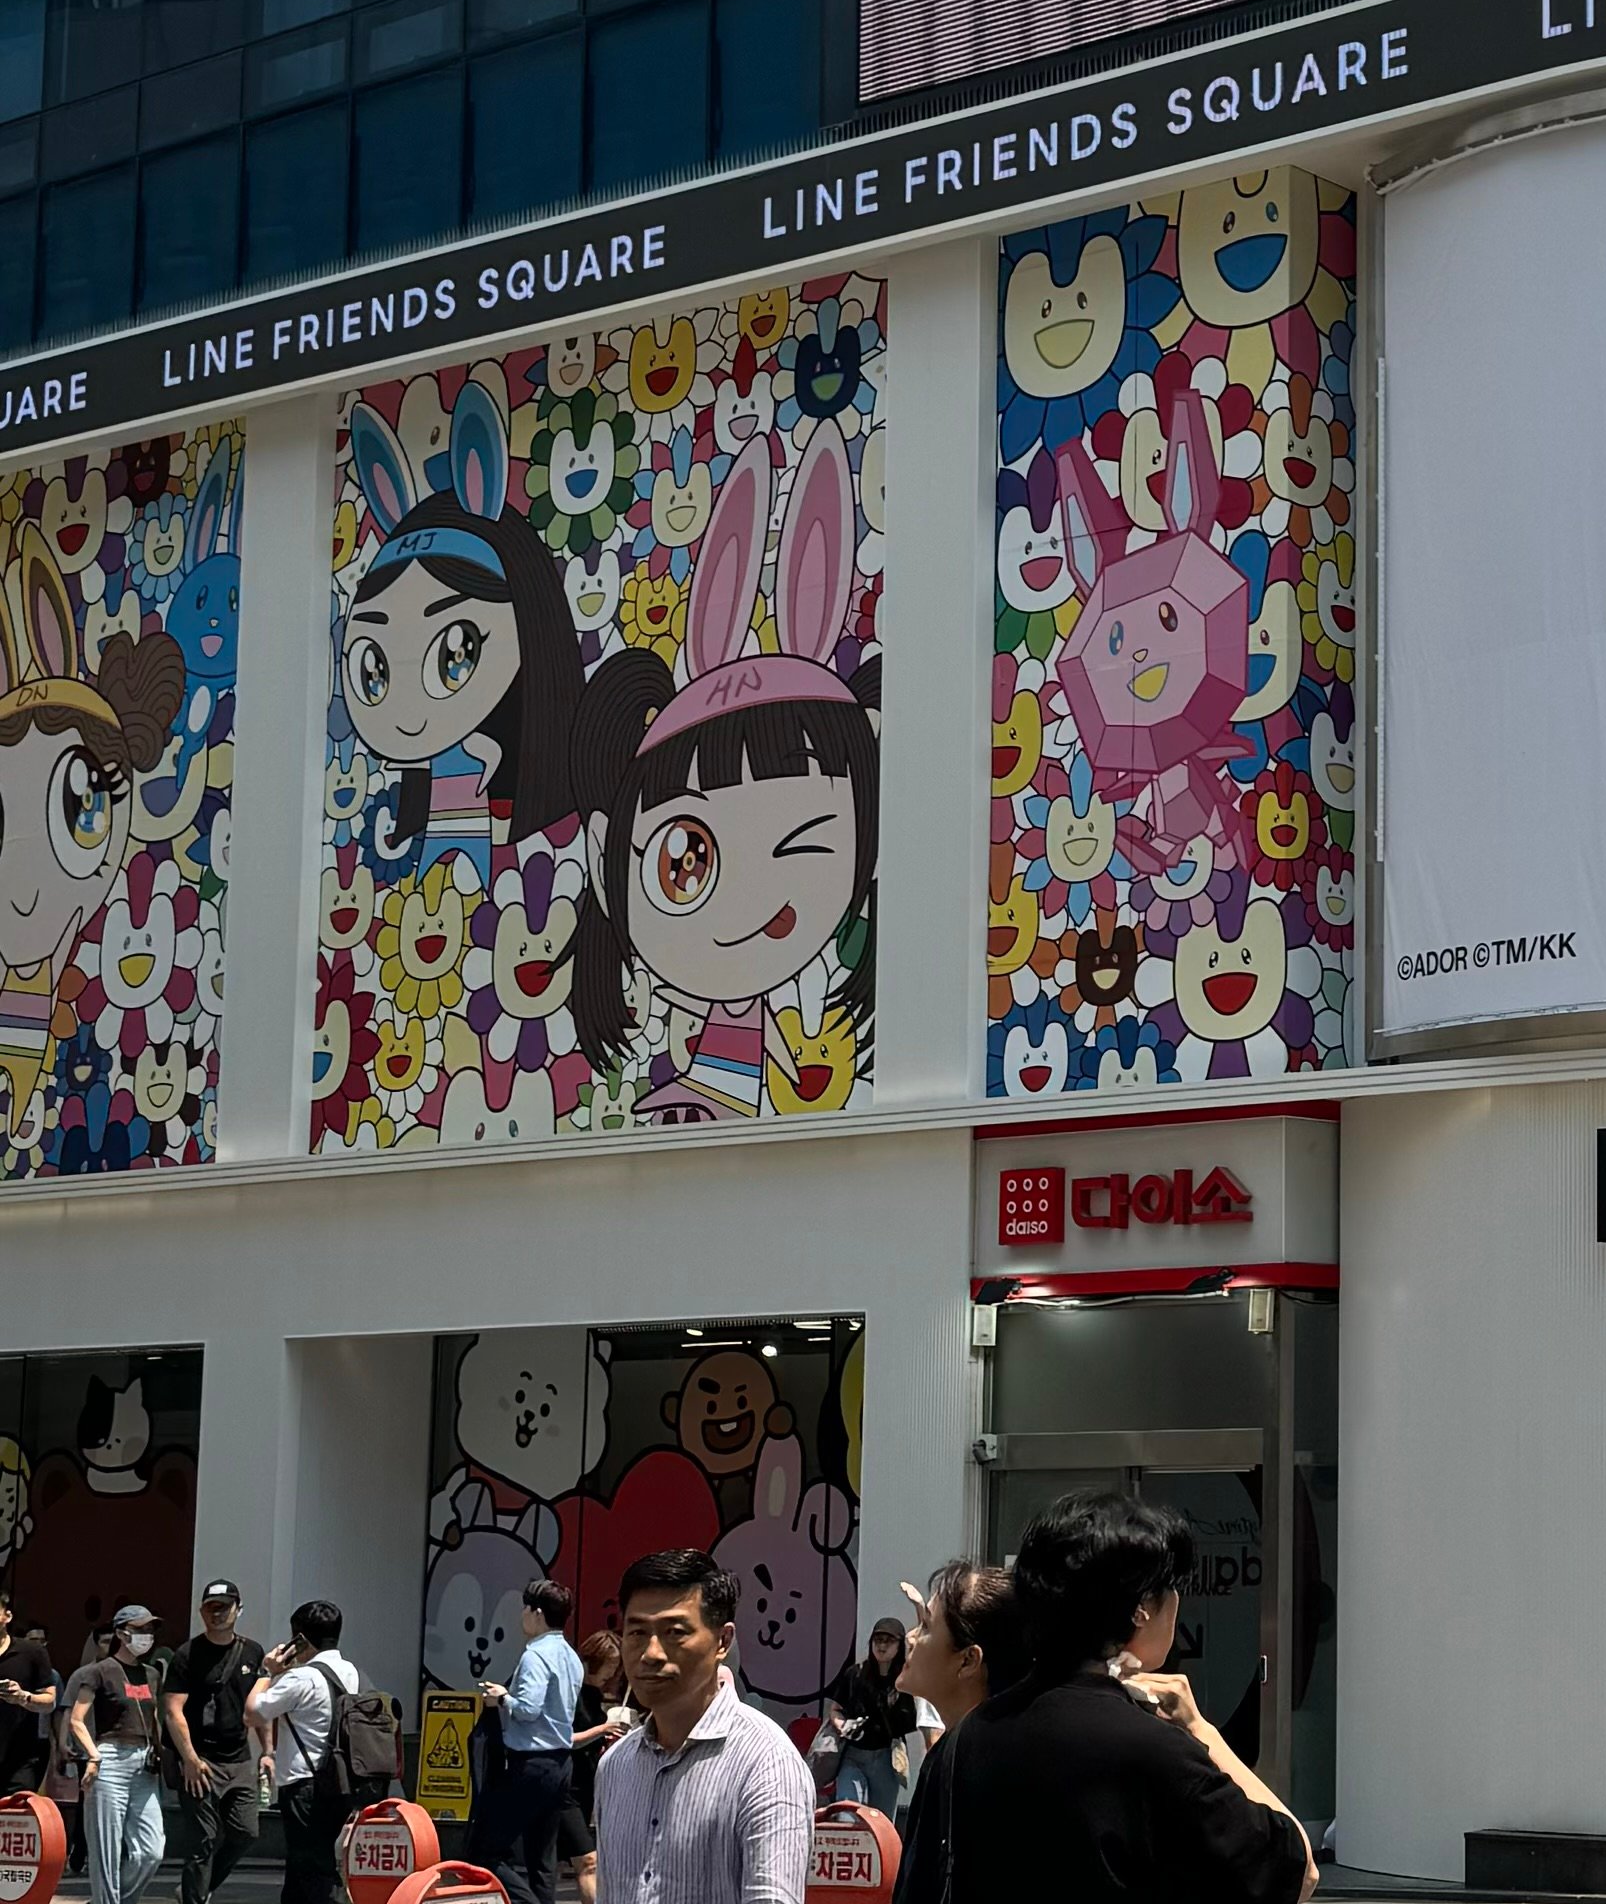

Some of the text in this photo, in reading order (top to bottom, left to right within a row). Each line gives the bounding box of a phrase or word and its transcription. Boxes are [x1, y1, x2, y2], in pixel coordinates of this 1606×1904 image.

[764, 29, 1407, 238] LINE FRIENDS SQUARE
[164, 226, 664, 386] LINE FRIENDS SQUARE
[1007, 1219, 1047, 1235] daiso
[1071, 1166, 1254, 1230] 다이소
